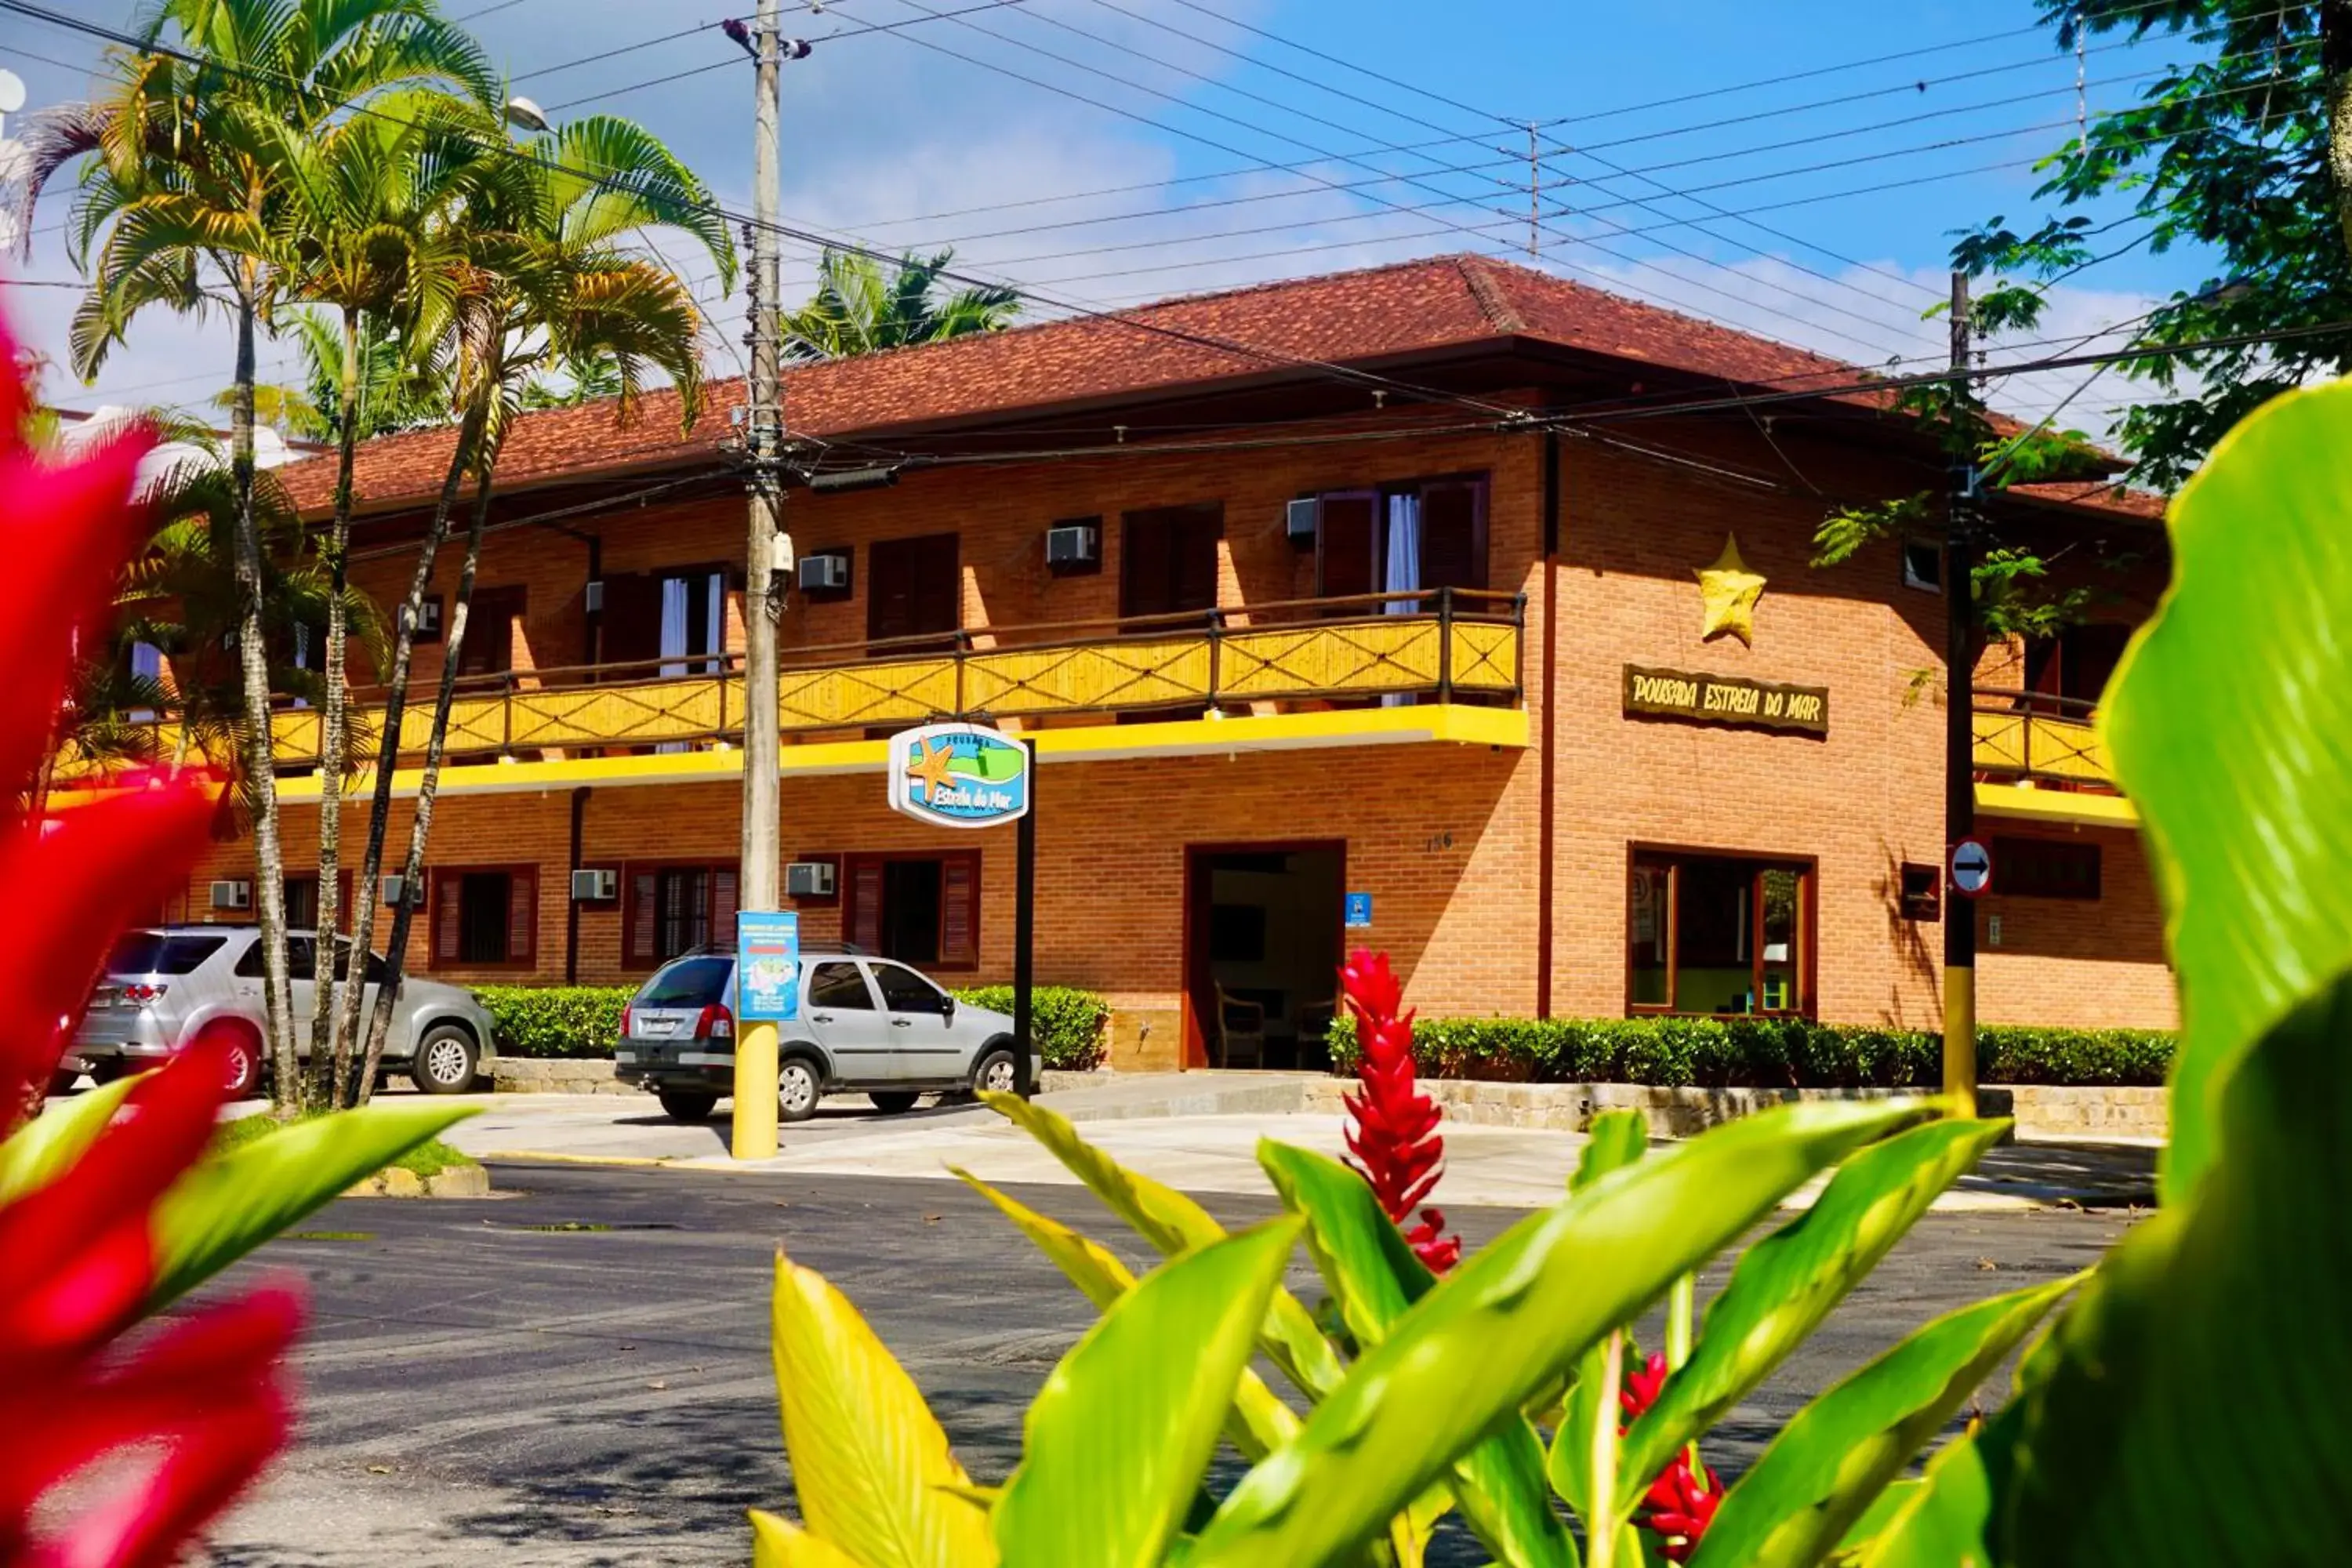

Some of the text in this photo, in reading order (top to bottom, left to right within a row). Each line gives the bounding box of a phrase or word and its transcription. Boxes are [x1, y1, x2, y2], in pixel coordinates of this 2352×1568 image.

[1633, 674, 1822, 721] POUSADA ESTRELA DO MAR
